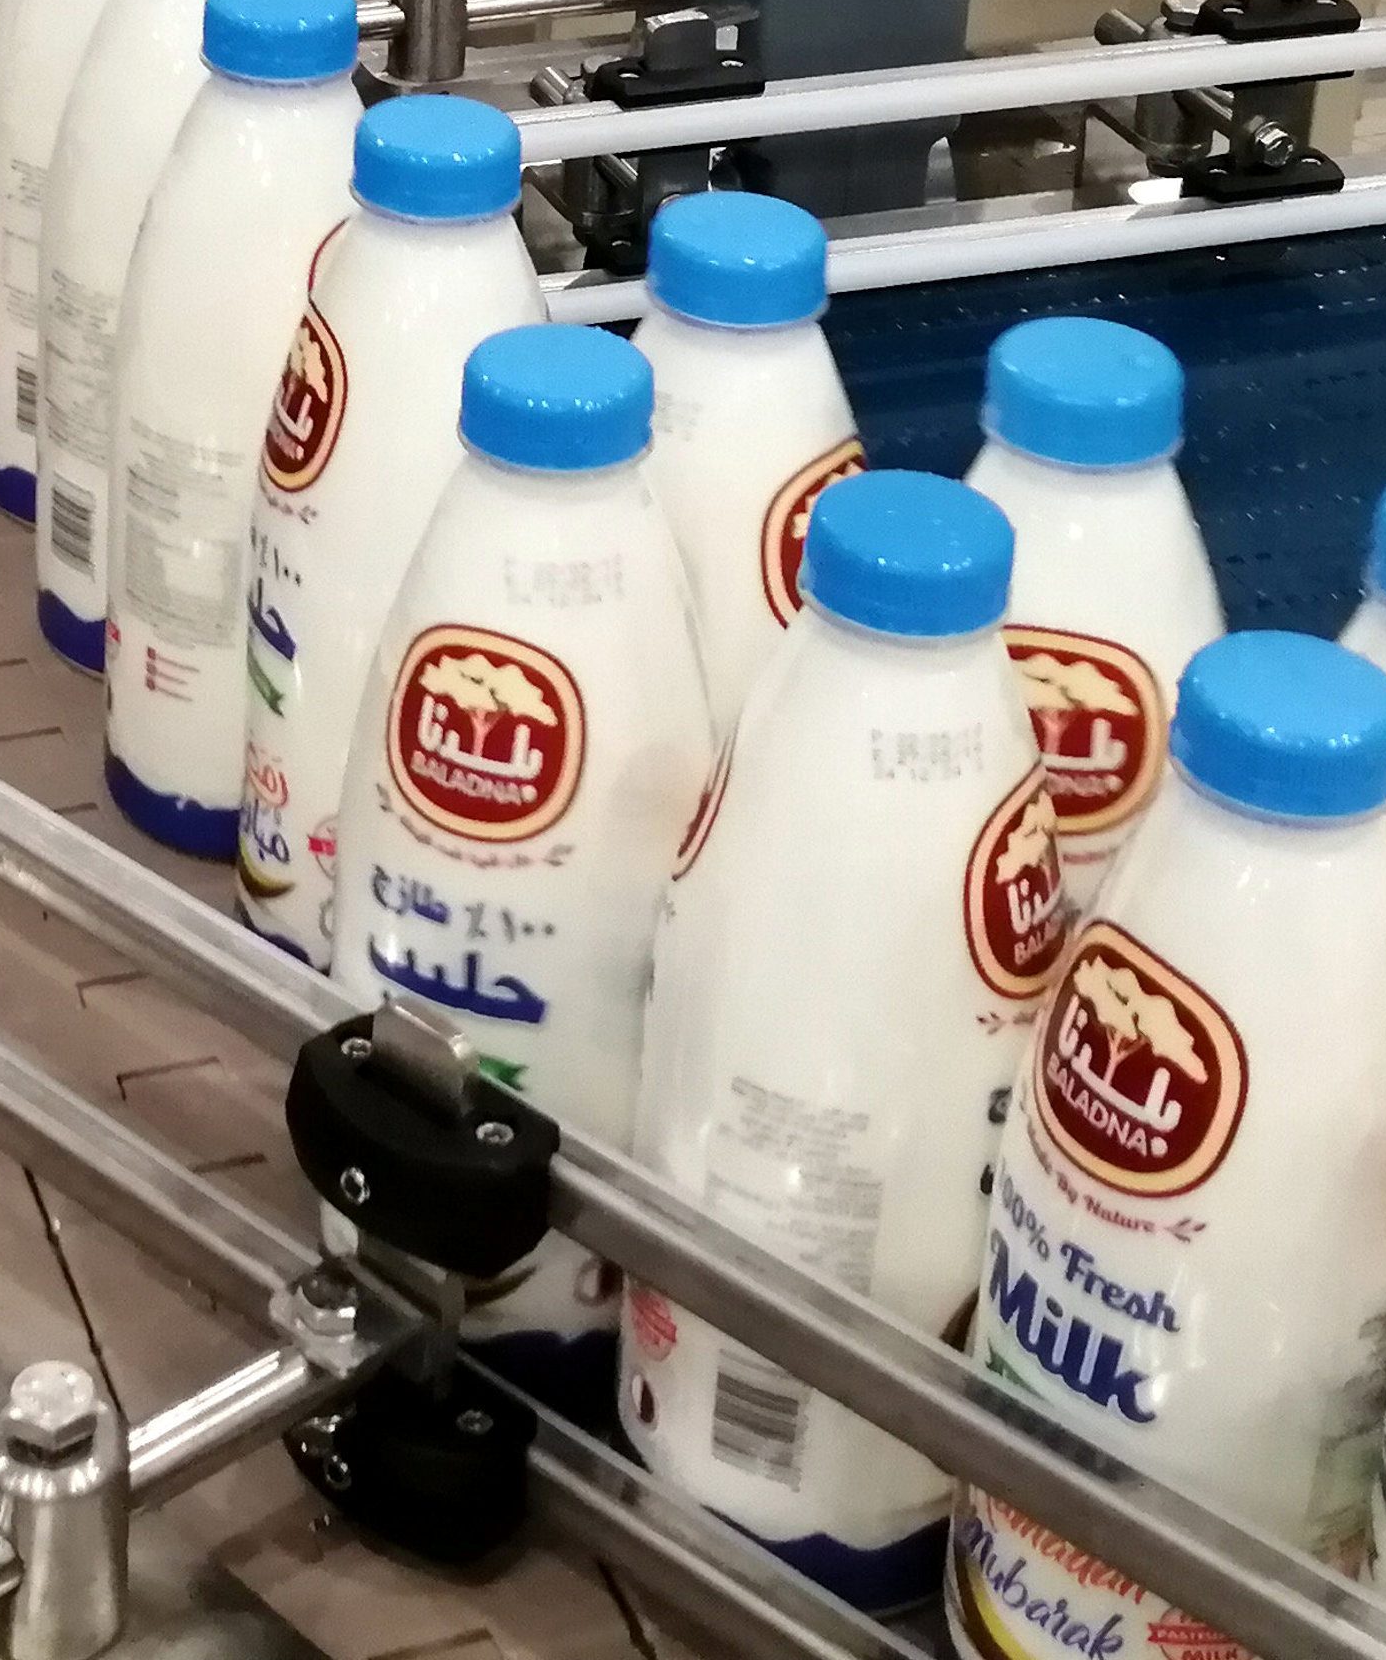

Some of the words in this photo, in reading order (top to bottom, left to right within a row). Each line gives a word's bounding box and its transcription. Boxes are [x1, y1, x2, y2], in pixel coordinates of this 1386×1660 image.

[1046, 1052, 1149, 1158] BALADNA
[1083, 1194, 1157, 1233] Nature
[989, 1227, 1157, 1425] Milk
[1059, 1240, 1181, 1333] Fresh
